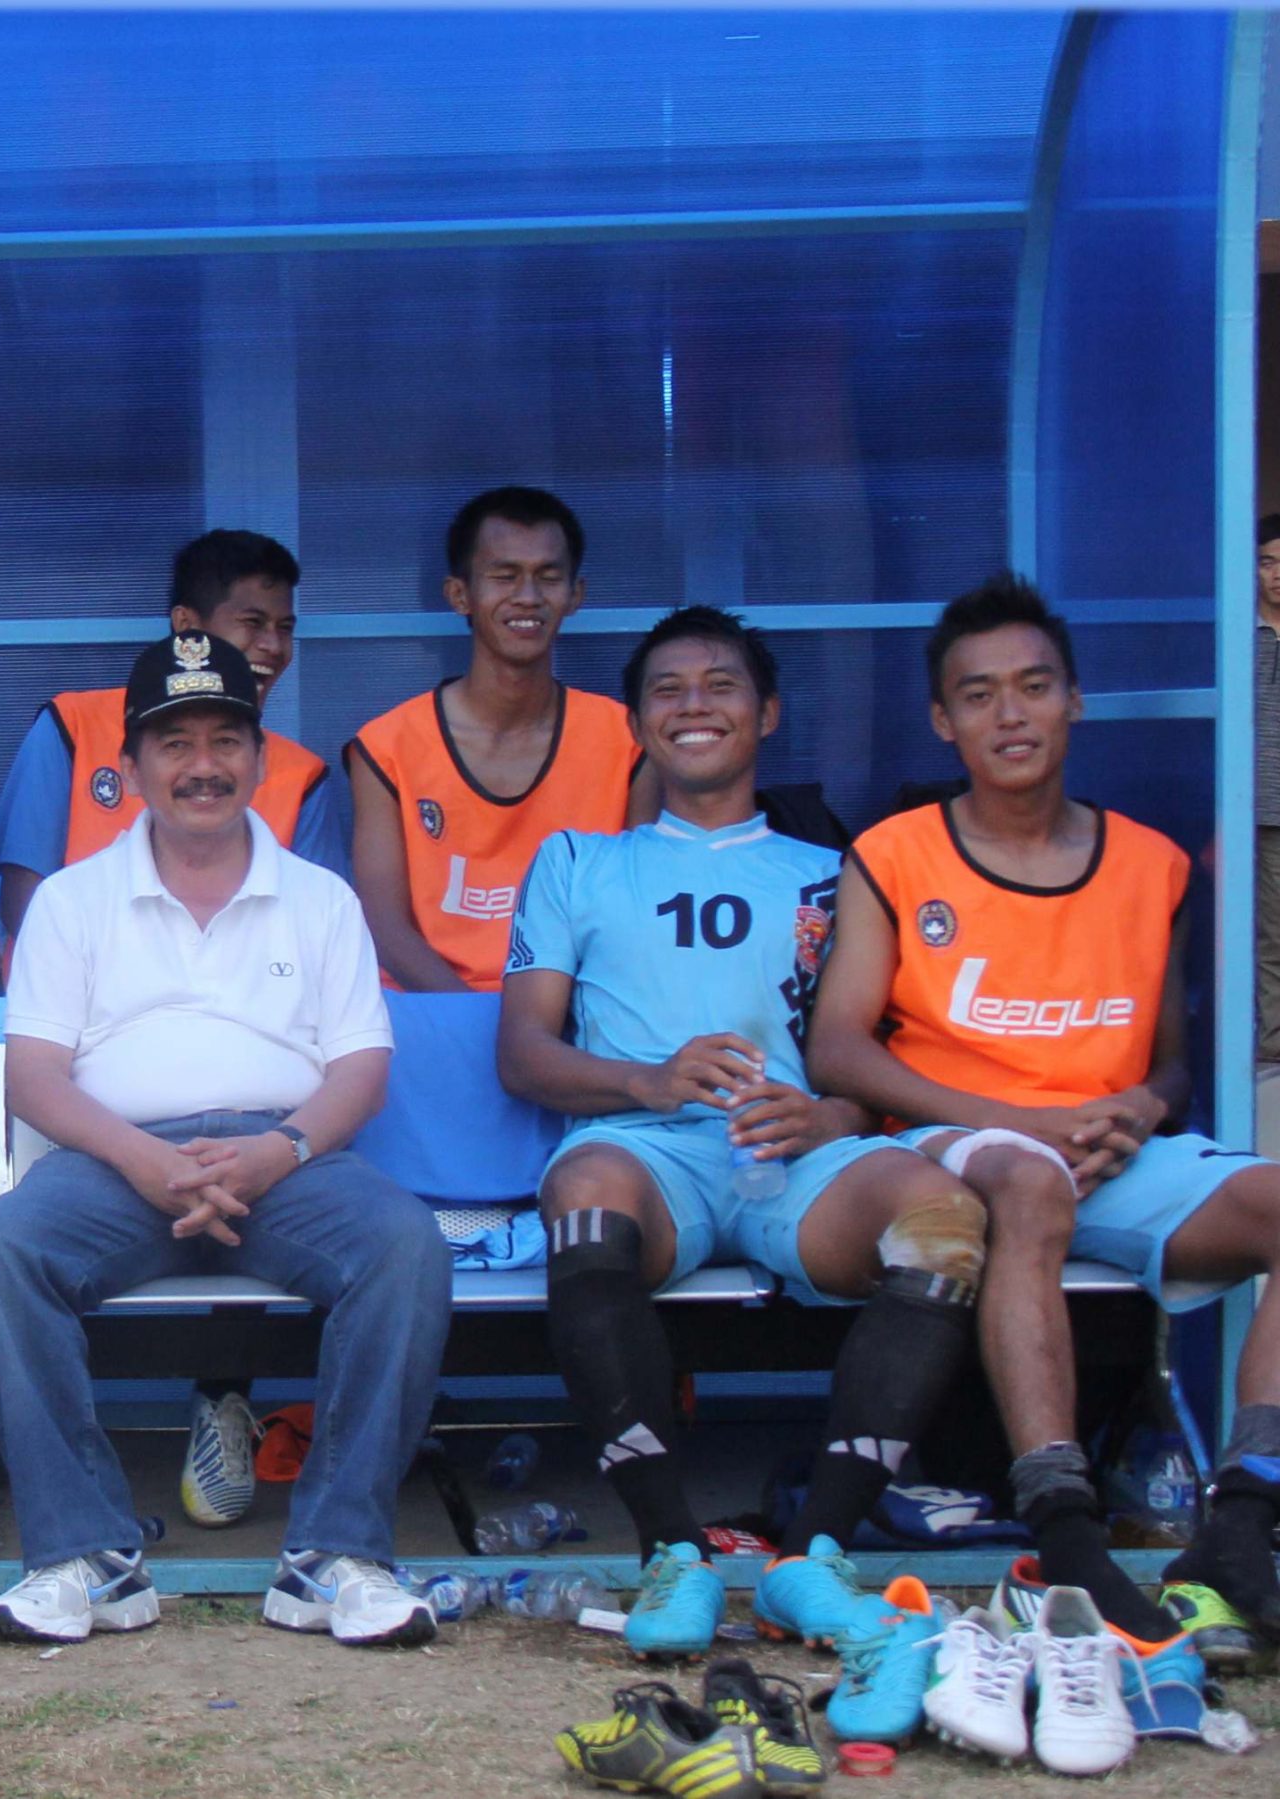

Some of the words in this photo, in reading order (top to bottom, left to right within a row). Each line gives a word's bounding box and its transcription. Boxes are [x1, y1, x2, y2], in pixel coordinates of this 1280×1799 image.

[440, 854, 516, 919] Lea
[657, 892, 753, 949] 10
[948, 957, 1135, 1036] League
